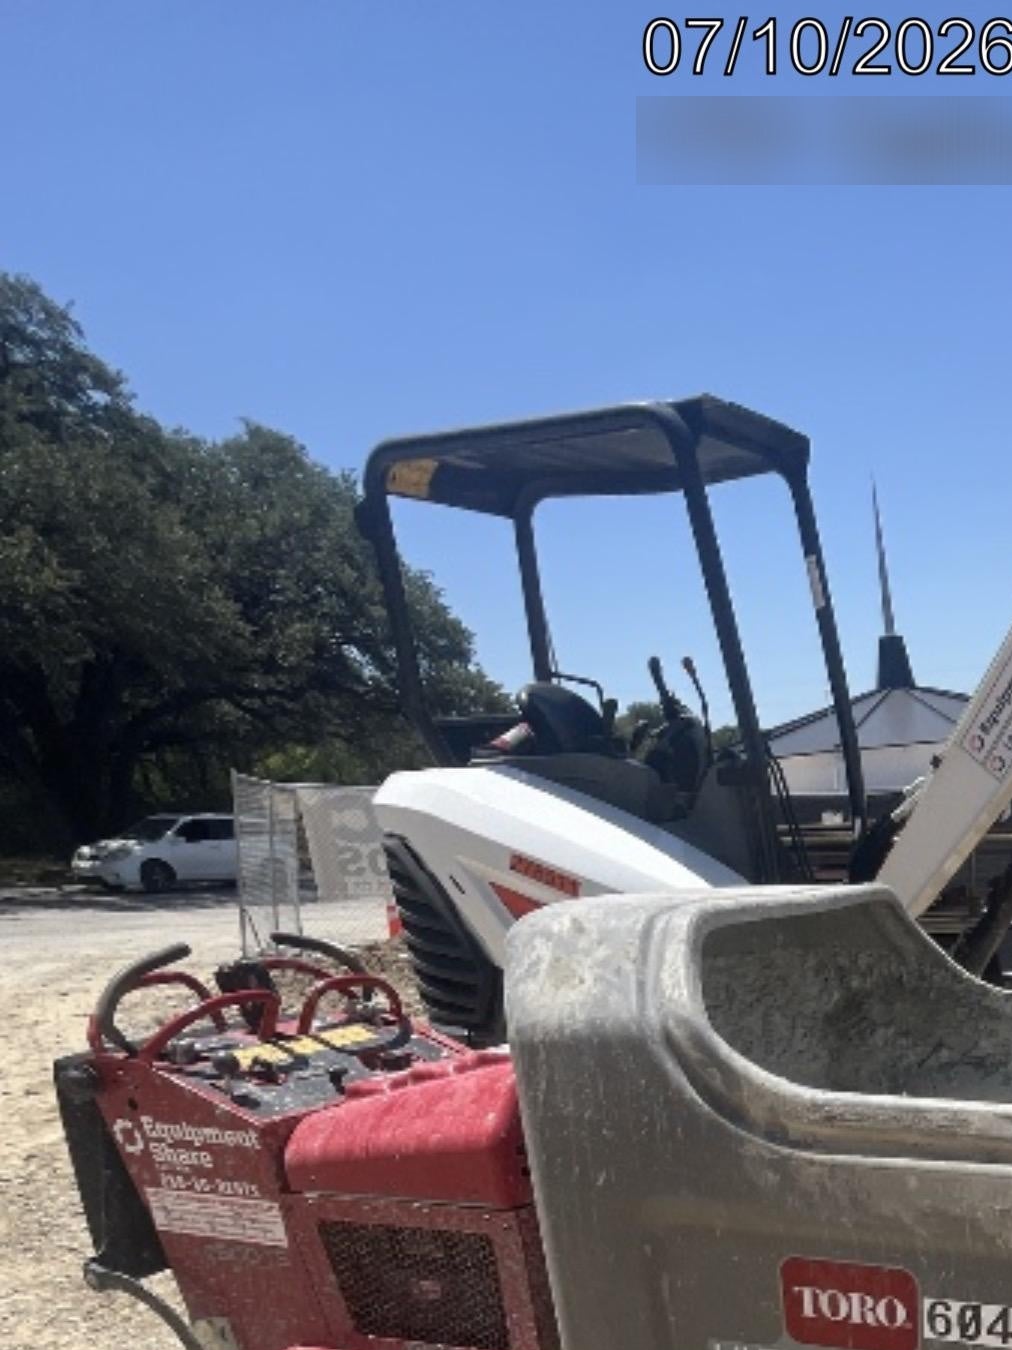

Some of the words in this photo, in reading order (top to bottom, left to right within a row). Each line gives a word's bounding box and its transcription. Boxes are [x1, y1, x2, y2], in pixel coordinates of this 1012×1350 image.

[140, 1115, 262, 1150] Equipment
[150, 1142, 214, 1168] Share
[793, 1285, 911, 1329] TORO
